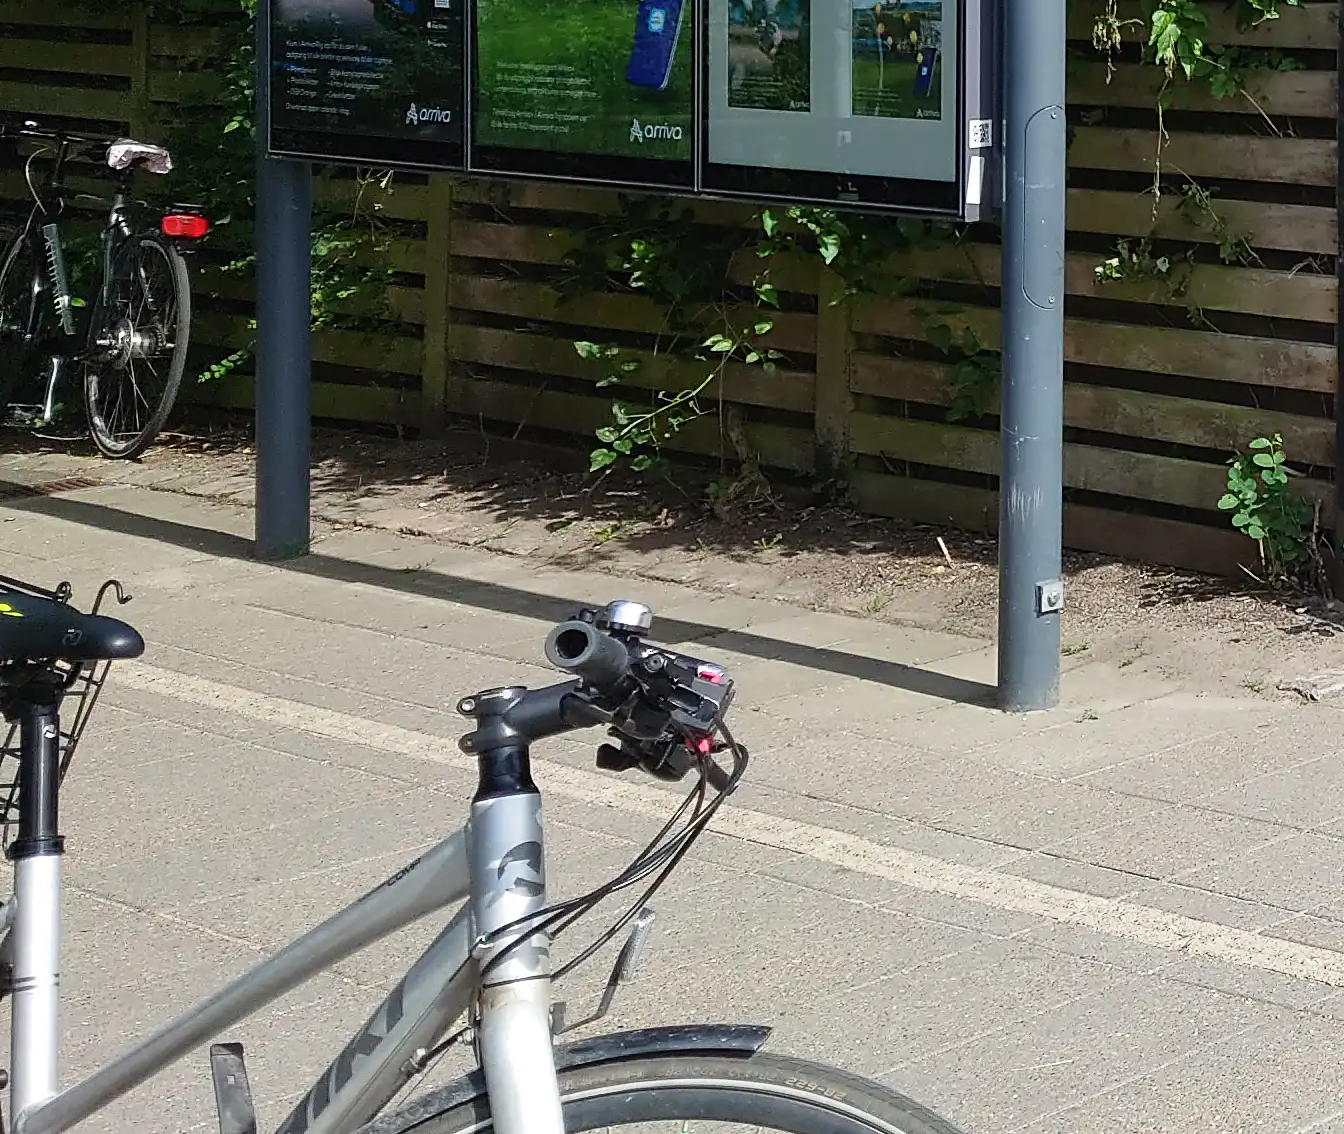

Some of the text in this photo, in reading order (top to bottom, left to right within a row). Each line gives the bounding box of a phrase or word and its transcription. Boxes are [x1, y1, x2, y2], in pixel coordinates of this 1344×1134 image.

[419, 106, 451, 123] arriva
[644, 122, 682, 140] arriva
[785, 1077, 848, 1101] 28-622
